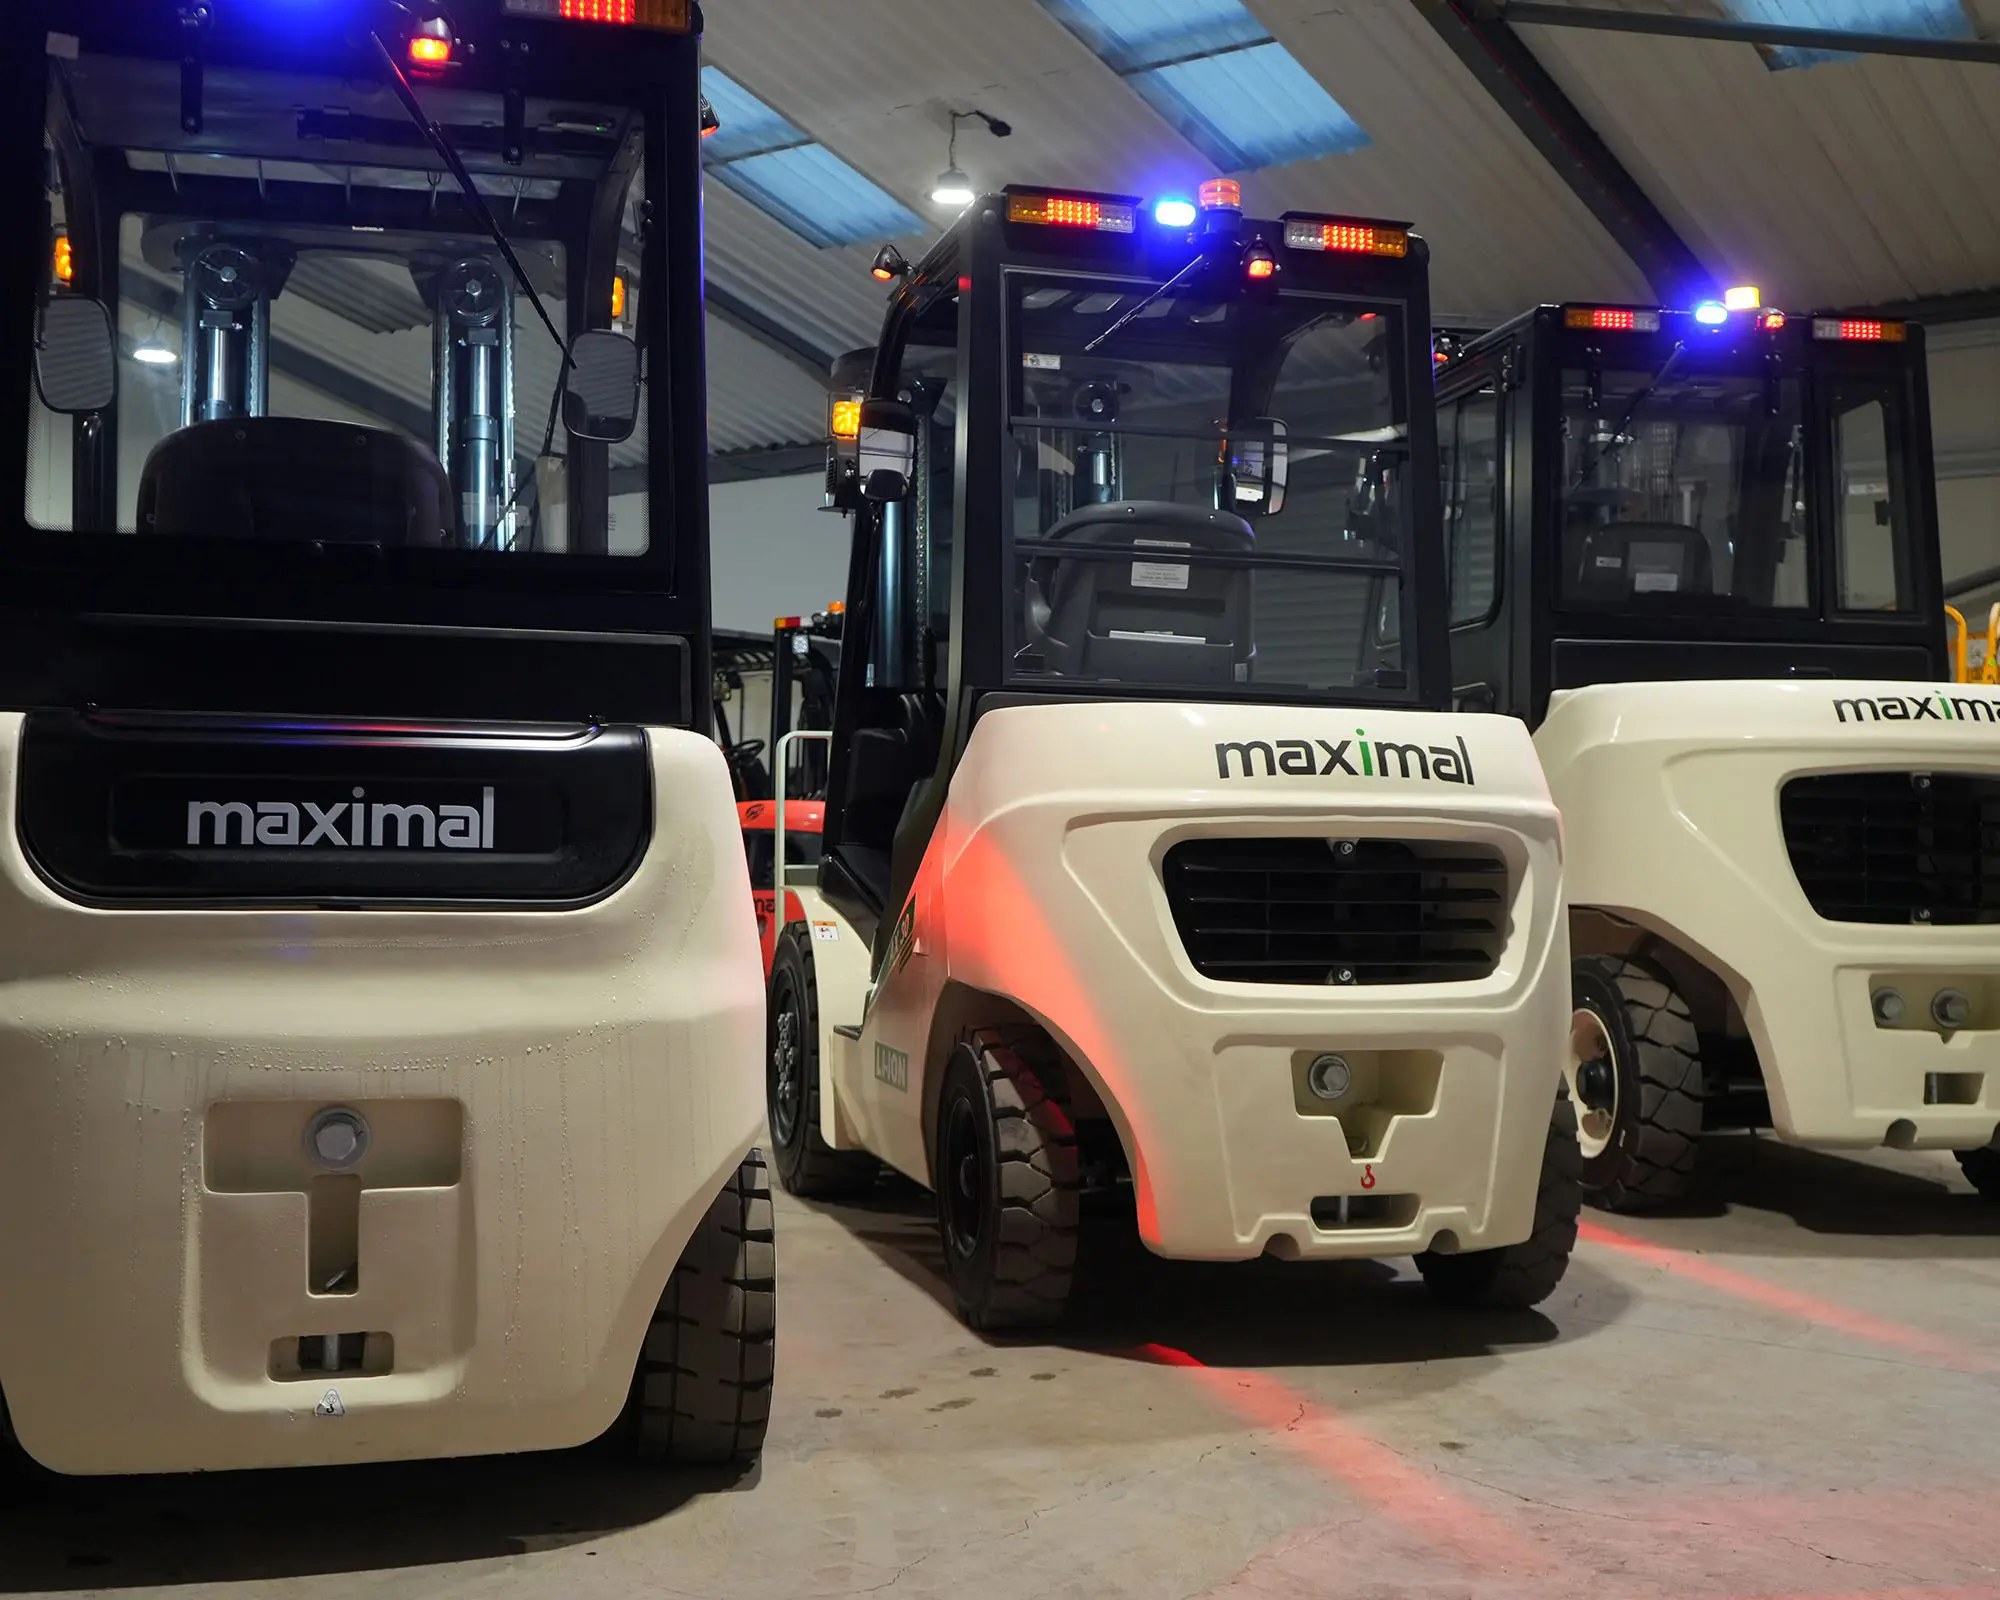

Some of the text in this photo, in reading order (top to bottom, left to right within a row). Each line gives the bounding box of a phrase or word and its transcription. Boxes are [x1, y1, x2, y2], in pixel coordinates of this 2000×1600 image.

[1832, 689, 2000, 723] maxim
[1214, 728, 1475, 786] maximal
[186, 786, 495, 849] maximal
